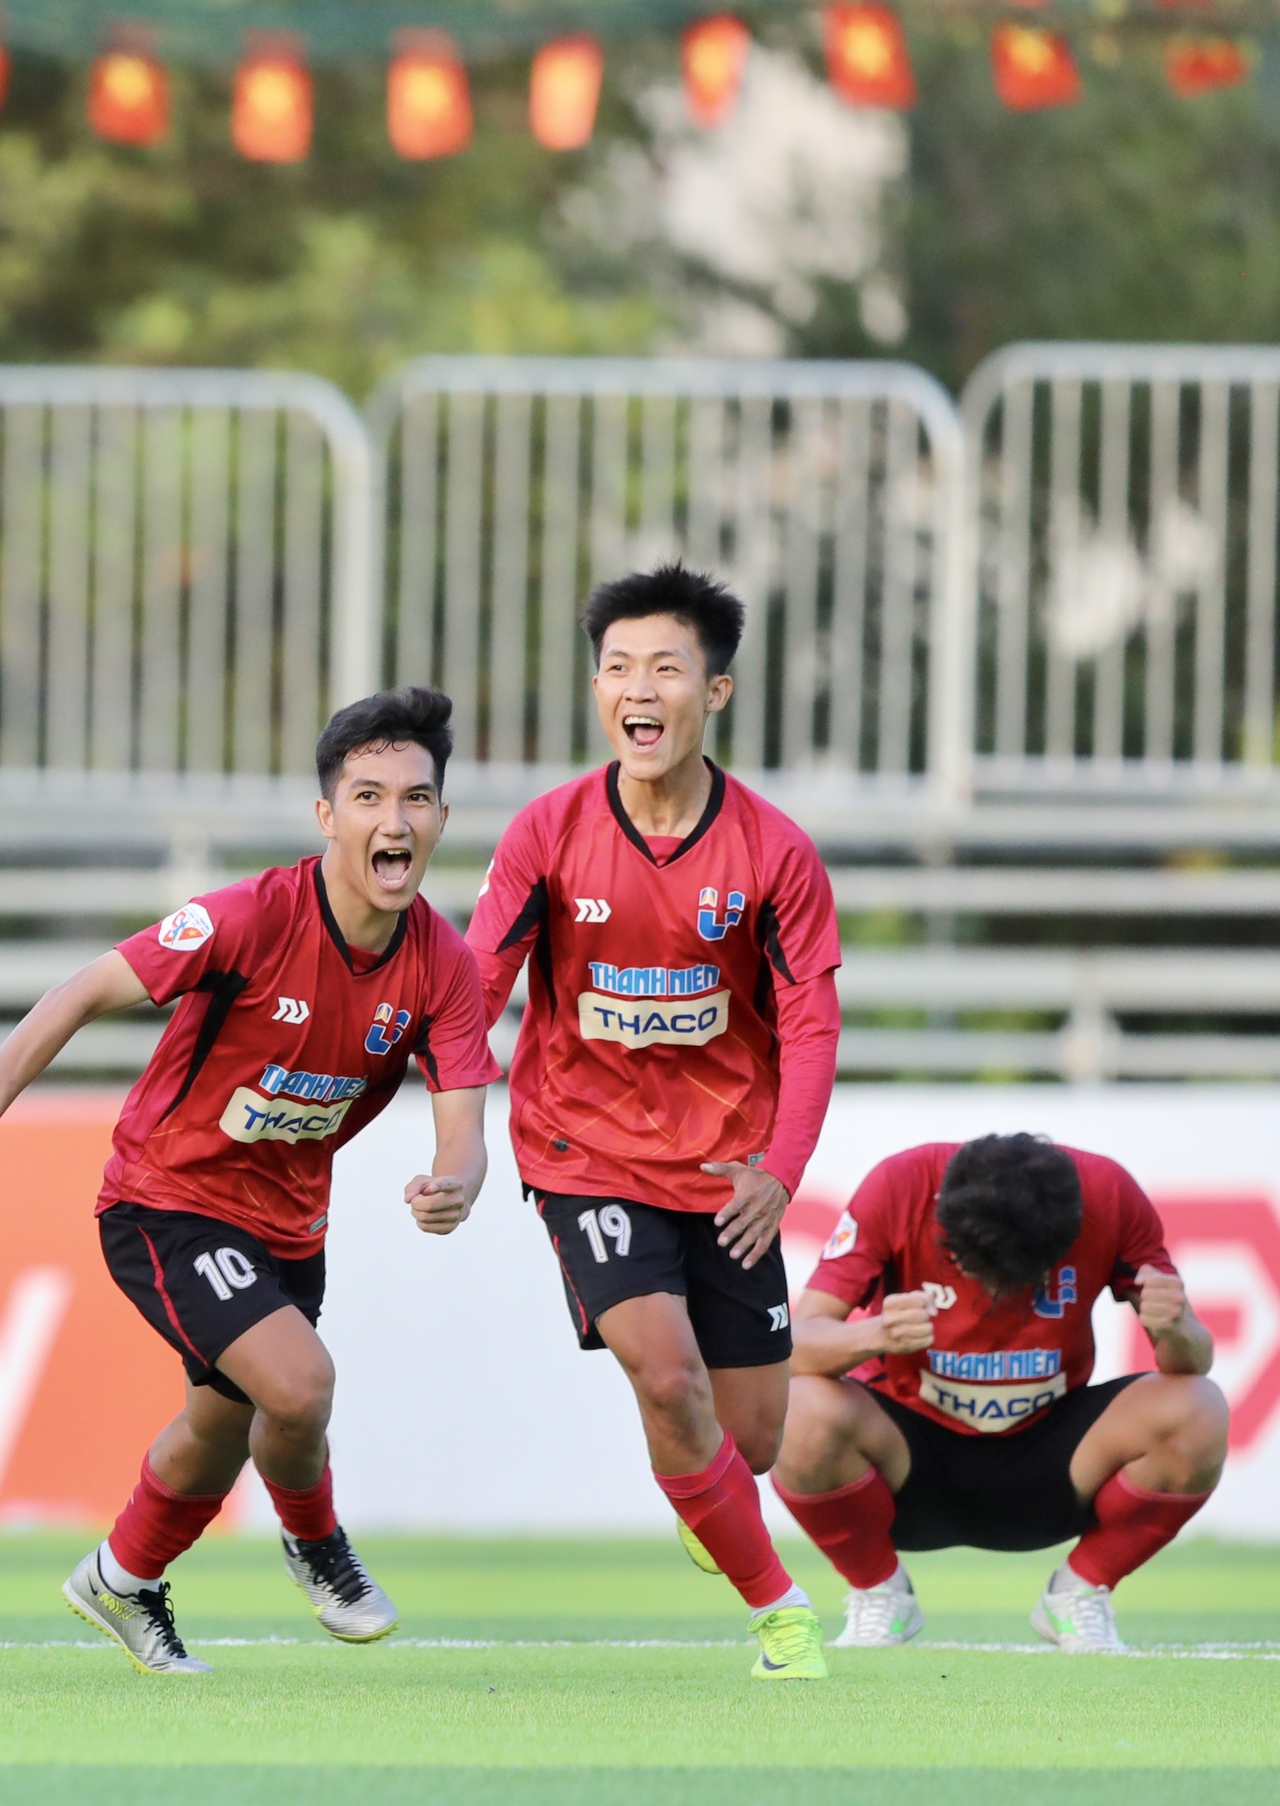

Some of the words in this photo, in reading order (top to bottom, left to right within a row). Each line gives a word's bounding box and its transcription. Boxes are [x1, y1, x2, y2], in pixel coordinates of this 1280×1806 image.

[588, 961, 667, 996] THANH
[593, 1006, 718, 1035] THACO
[244, 1104, 343, 1134] THACO
[577, 1203, 632, 1264] 19
[192, 1246, 258, 1301] 10
[927, 1349, 1005, 1380] THANH
[932, 1383, 1055, 1419] THACO
